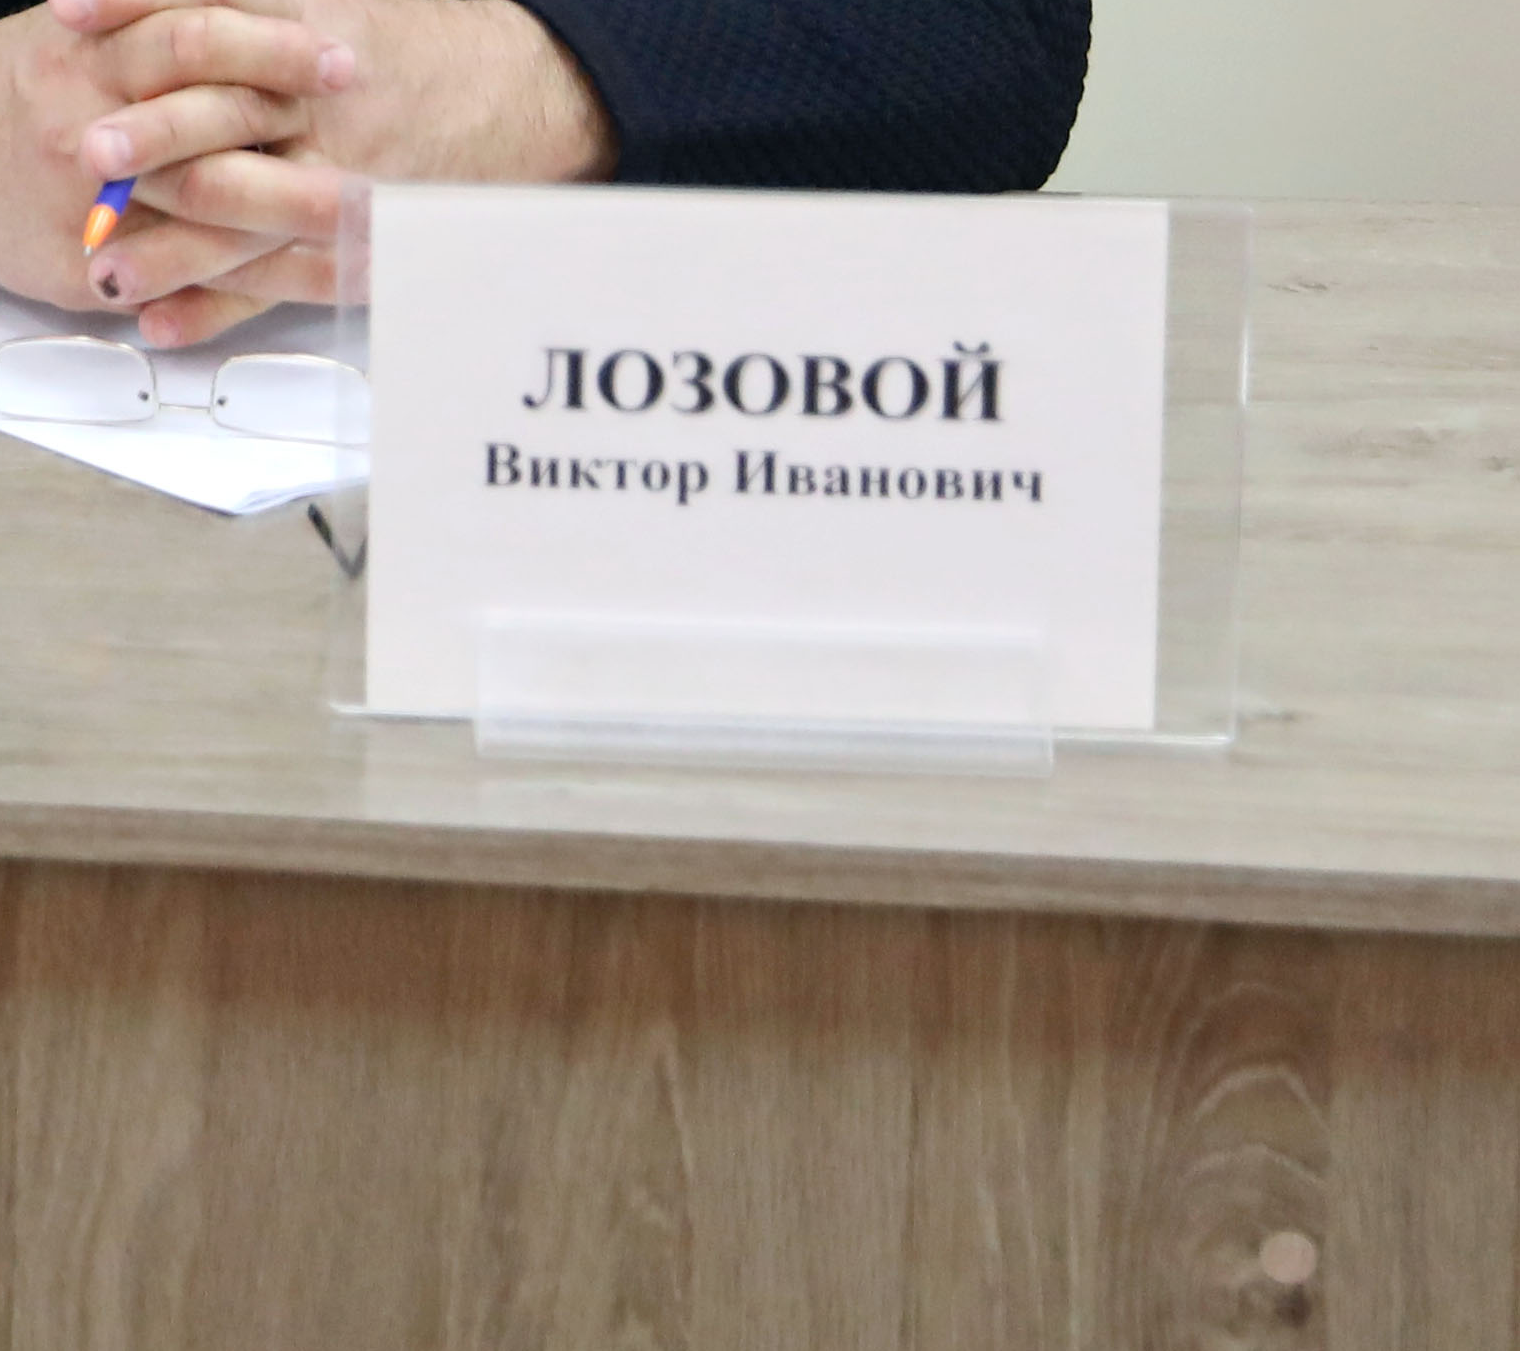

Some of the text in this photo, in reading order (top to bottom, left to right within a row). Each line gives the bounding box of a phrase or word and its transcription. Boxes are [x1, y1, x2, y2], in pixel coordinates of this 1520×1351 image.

[521, 341, 1004, 423] ЛОЗОВОЙ
[484, 442, 1044, 506] Виктор Иванович
